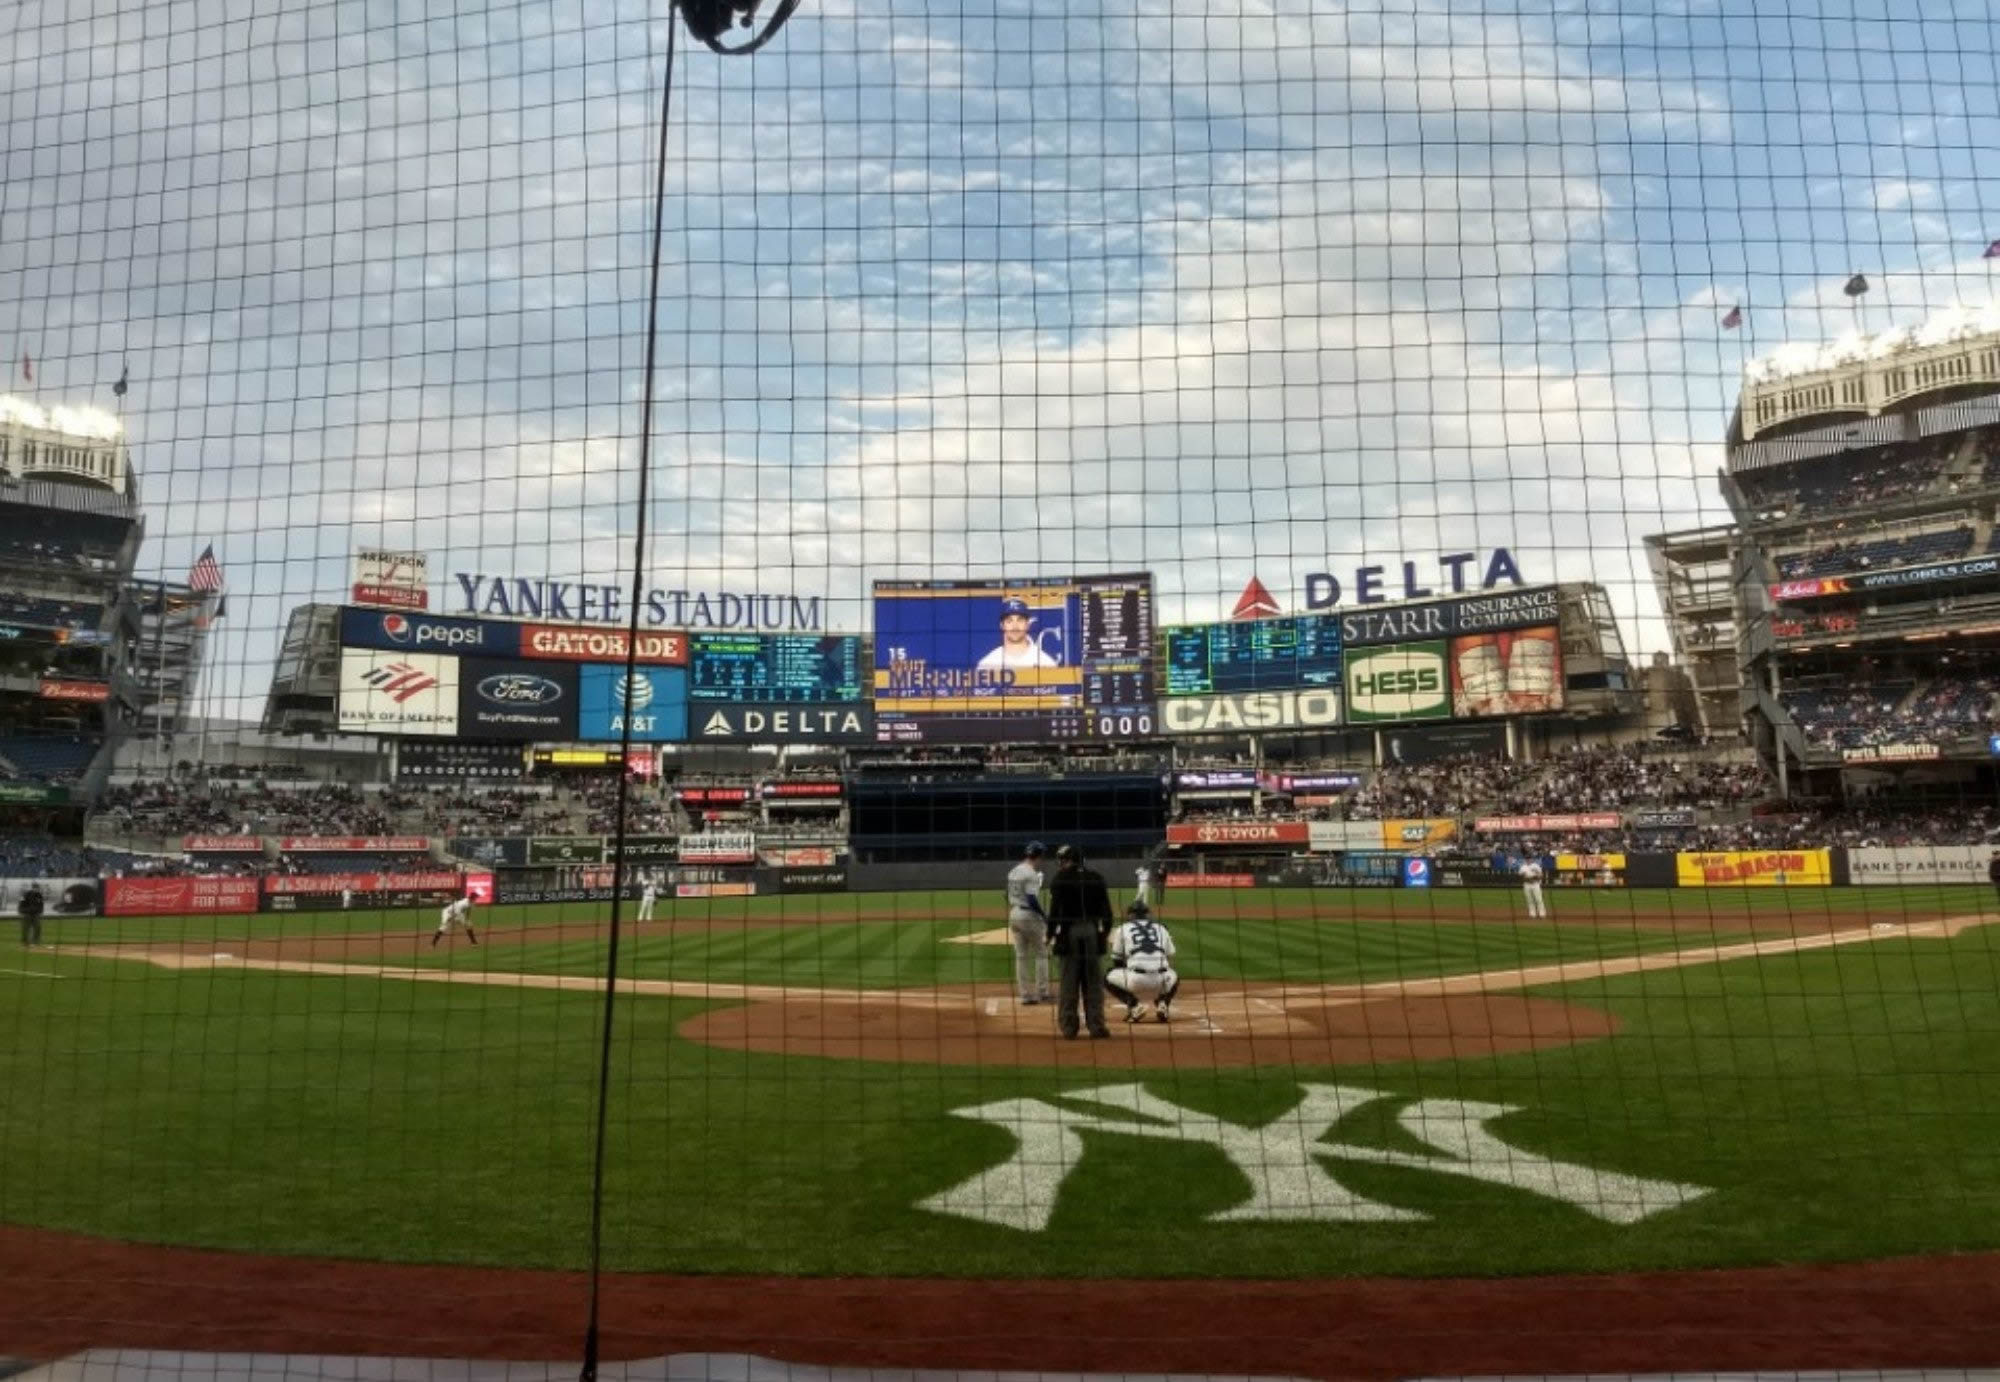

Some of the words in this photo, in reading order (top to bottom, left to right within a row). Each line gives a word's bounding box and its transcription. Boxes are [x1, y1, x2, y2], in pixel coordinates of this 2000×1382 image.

[1306, 548, 1523, 609] DELTA
[455, 573, 622, 622] YANKEE
[646, 588, 821, 630] STADIUM
[1460, 591, 1559, 616] INSURANCE
[1343, 608, 1449, 642] STARR
[1460, 604, 1559, 630] COMPANIES
[416, 624, 483, 646] pepsi
[533, 631, 678, 658] GATORADE
[493, 681, 546, 701] Ford
[1356, 668, 1438, 696] HESS
[744, 711, 862, 733] DELTA
[1165, 689, 1337, 731] CASIO
[1222, 827, 1279, 839] TOYOTA
[1853, 861, 1890, 872] BANK
[1896, 862, 1912, 872] OF
[1917, 860, 1982, 872] AMERICA
